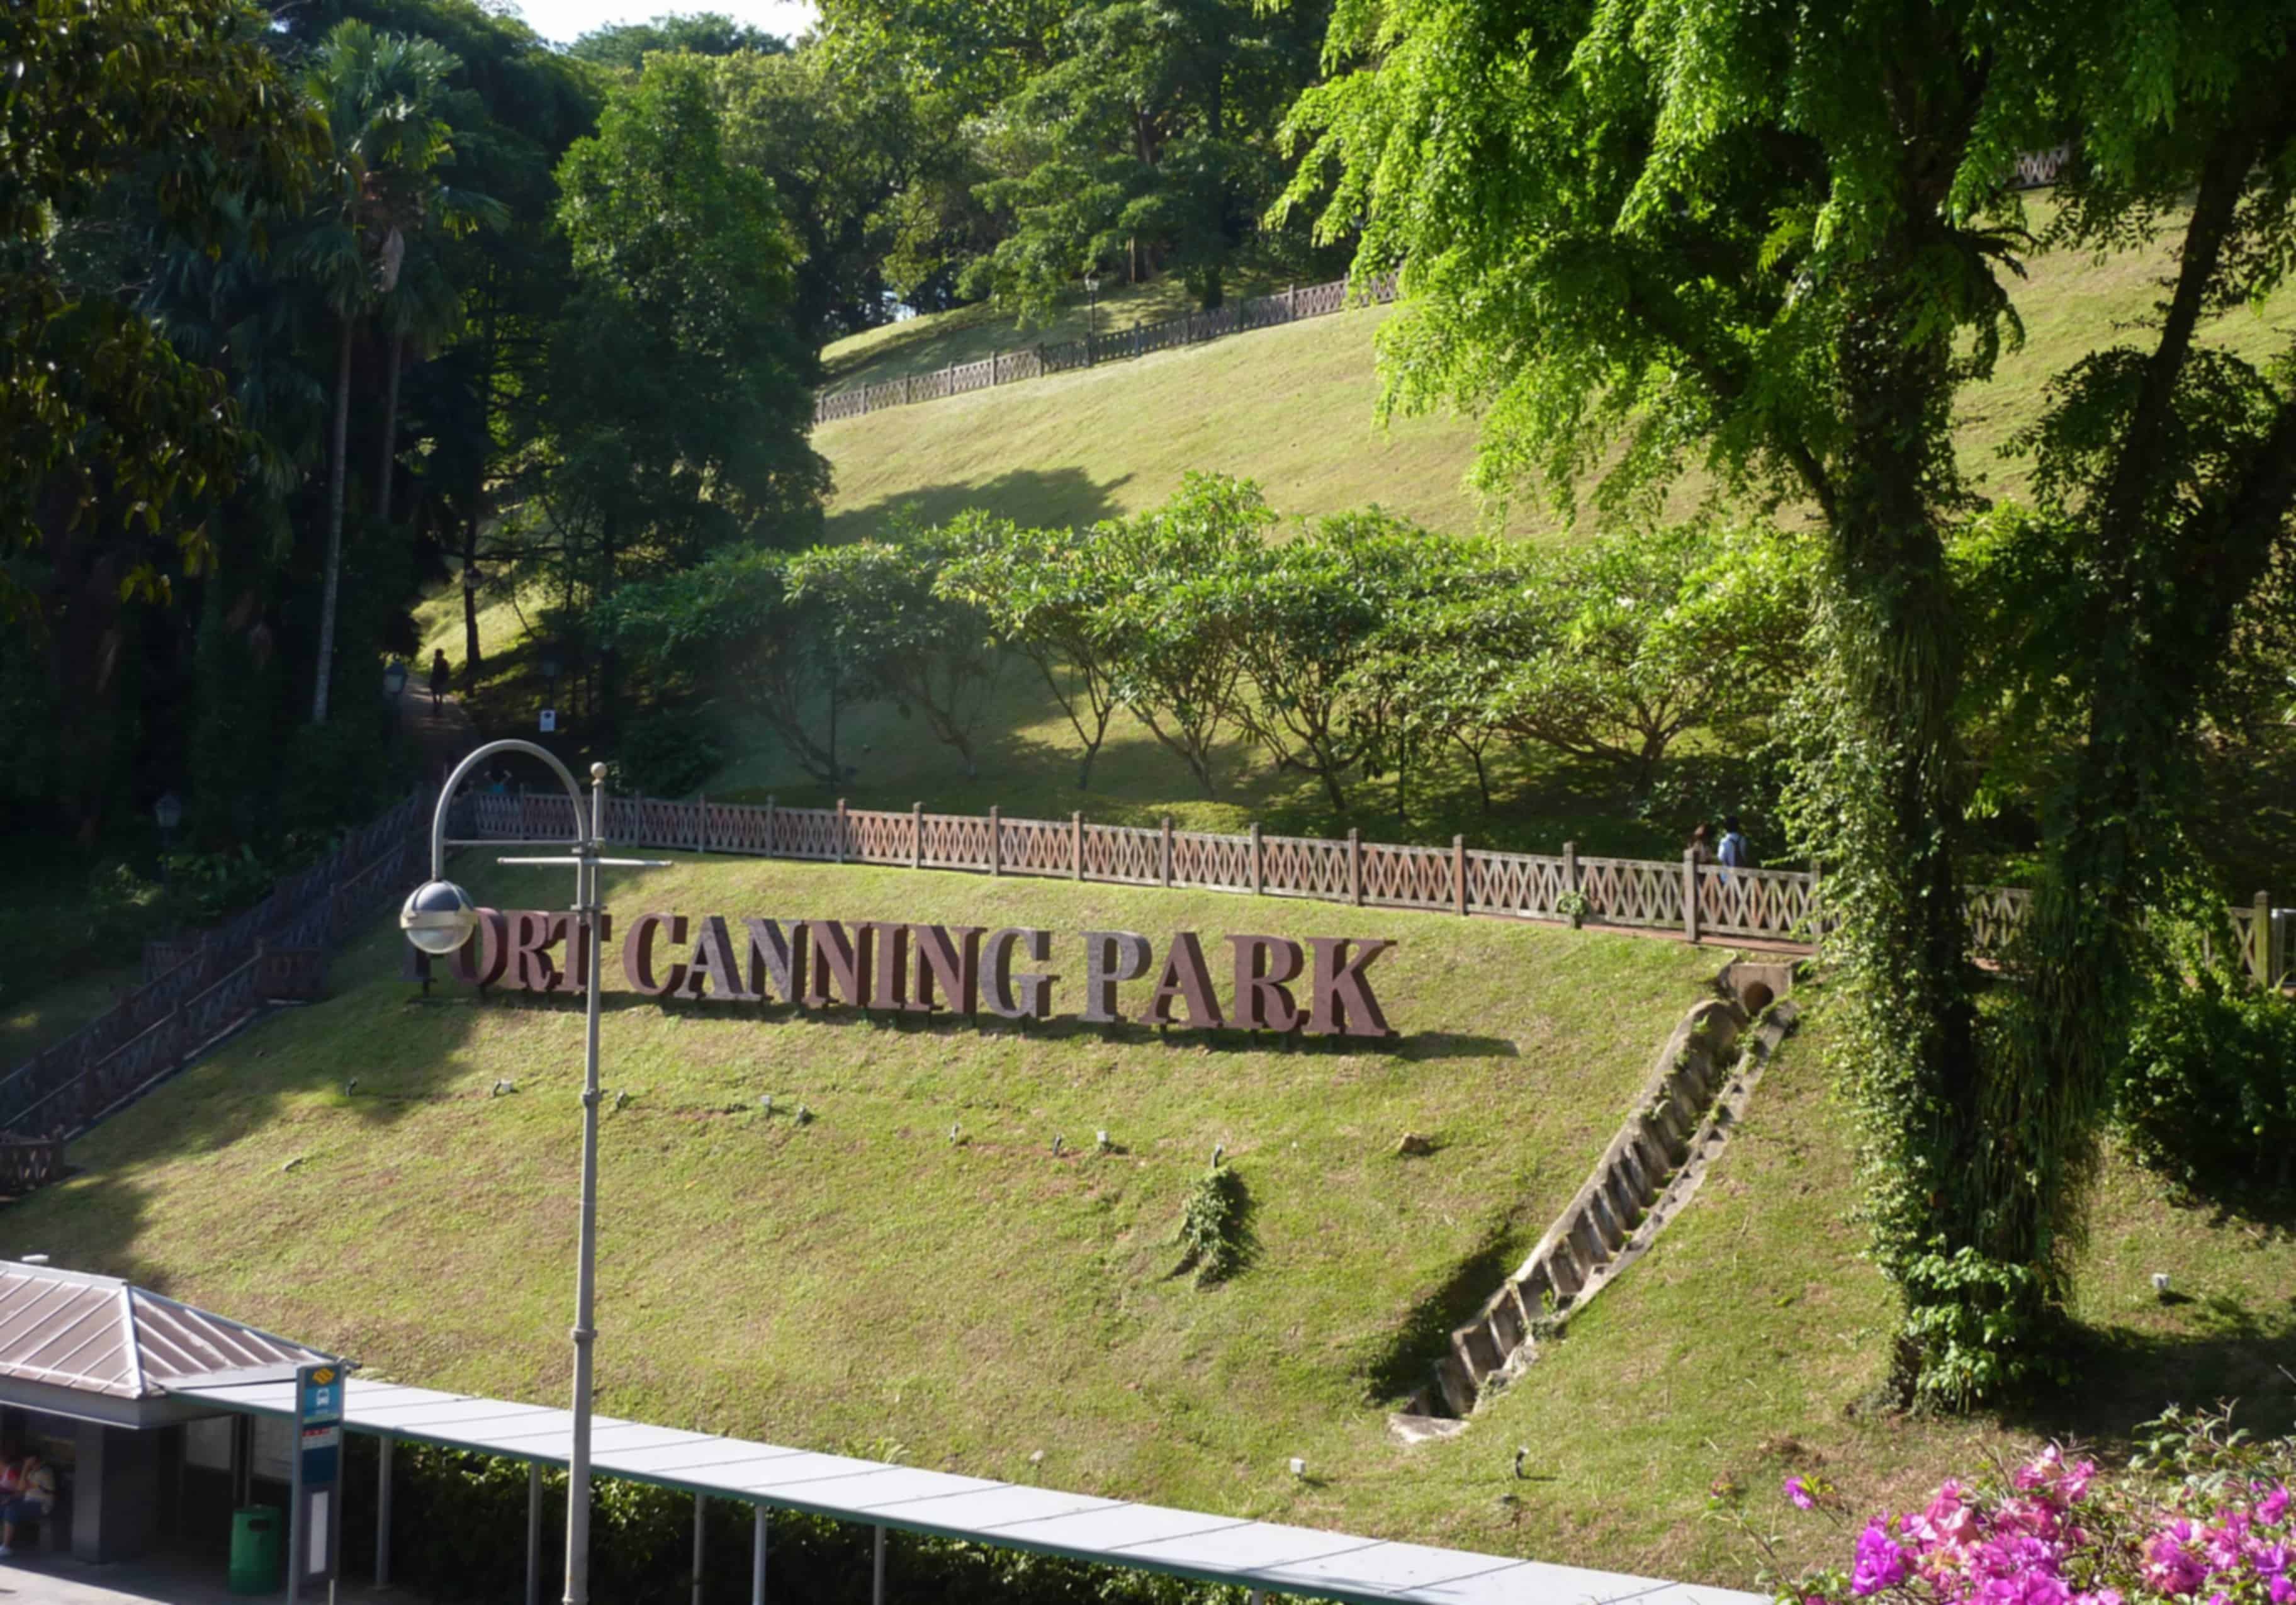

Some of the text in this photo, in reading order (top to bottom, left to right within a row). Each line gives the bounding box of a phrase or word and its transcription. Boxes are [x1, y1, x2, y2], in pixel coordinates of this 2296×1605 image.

[399, 907, 1400, 1039] ORT CANNING PARK
